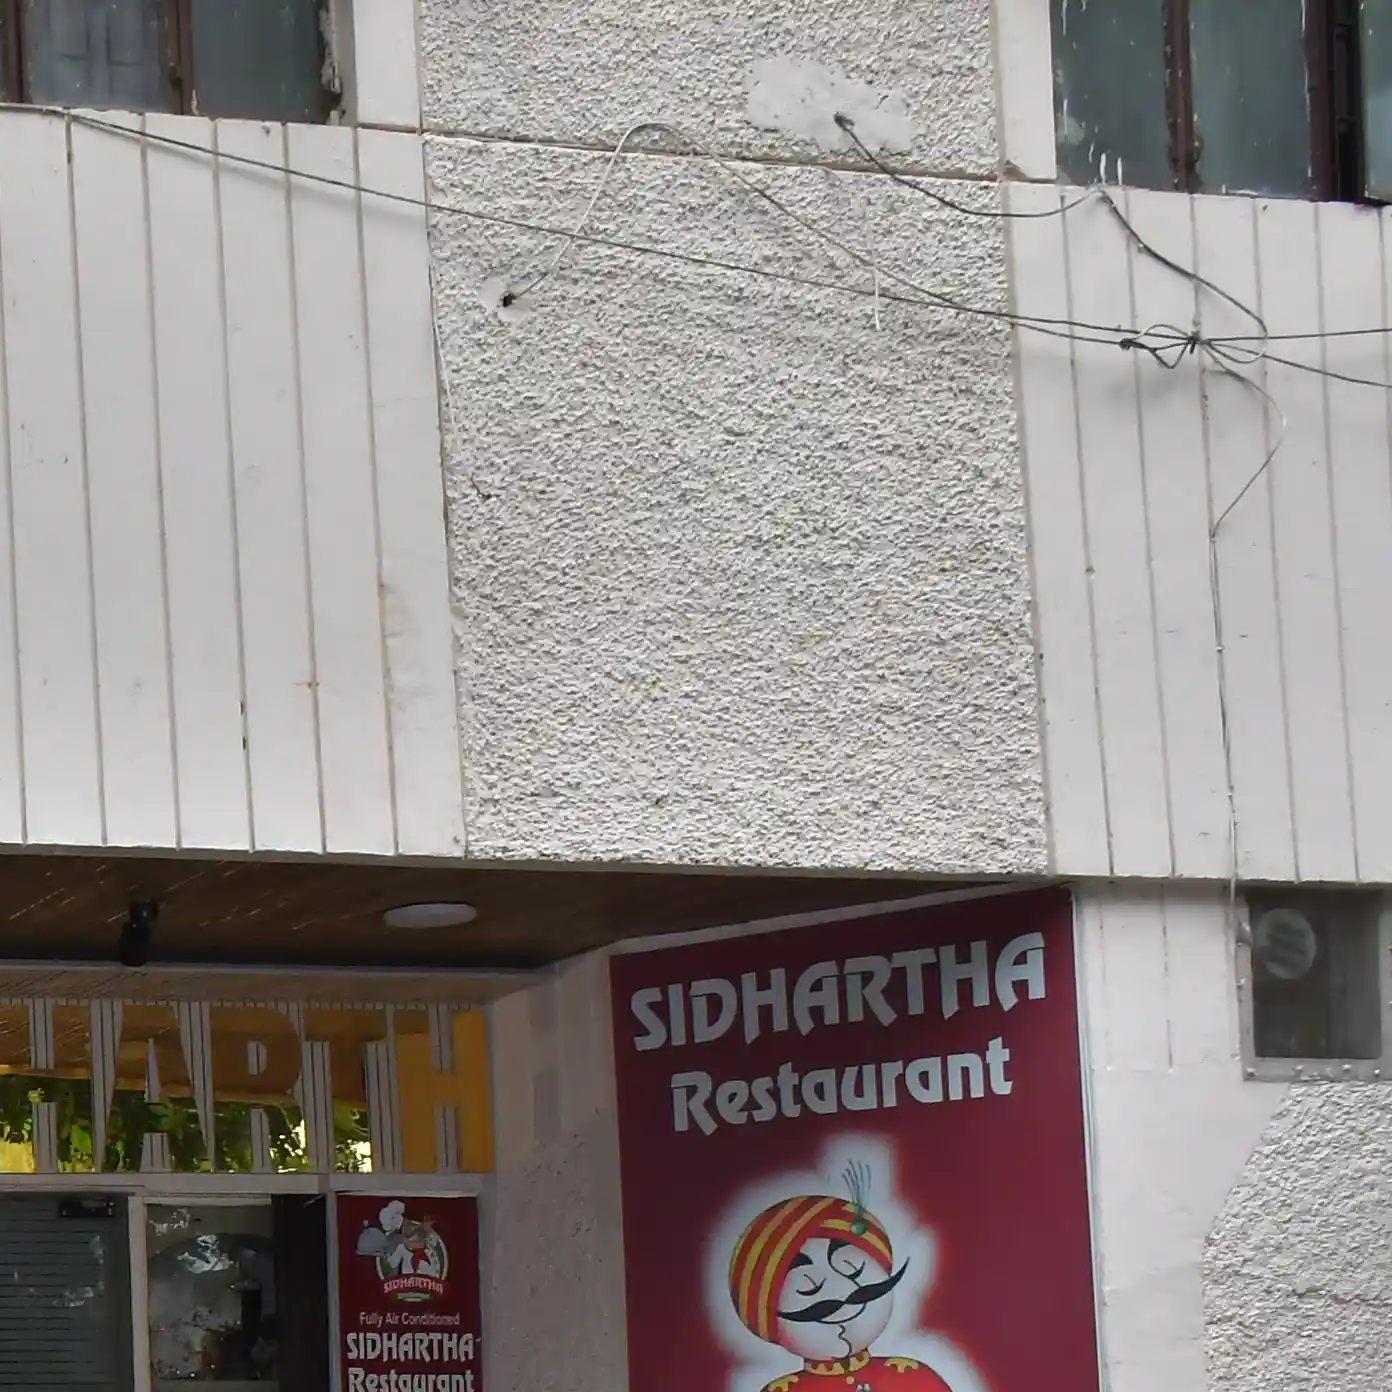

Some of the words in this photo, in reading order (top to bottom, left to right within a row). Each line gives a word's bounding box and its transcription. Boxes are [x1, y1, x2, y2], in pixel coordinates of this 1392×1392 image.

[629, 932, 1045, 1052] SIDHARTHA
[671, 1036, 1013, 1136] Restaurant
[346, 1332, 474, 1362] SIDHARTHA
[360, 1312, 382, 1327] Fully
[386, 1312, 399, 1325] Air
[401, 1312, 460, 1325] Conditioned
